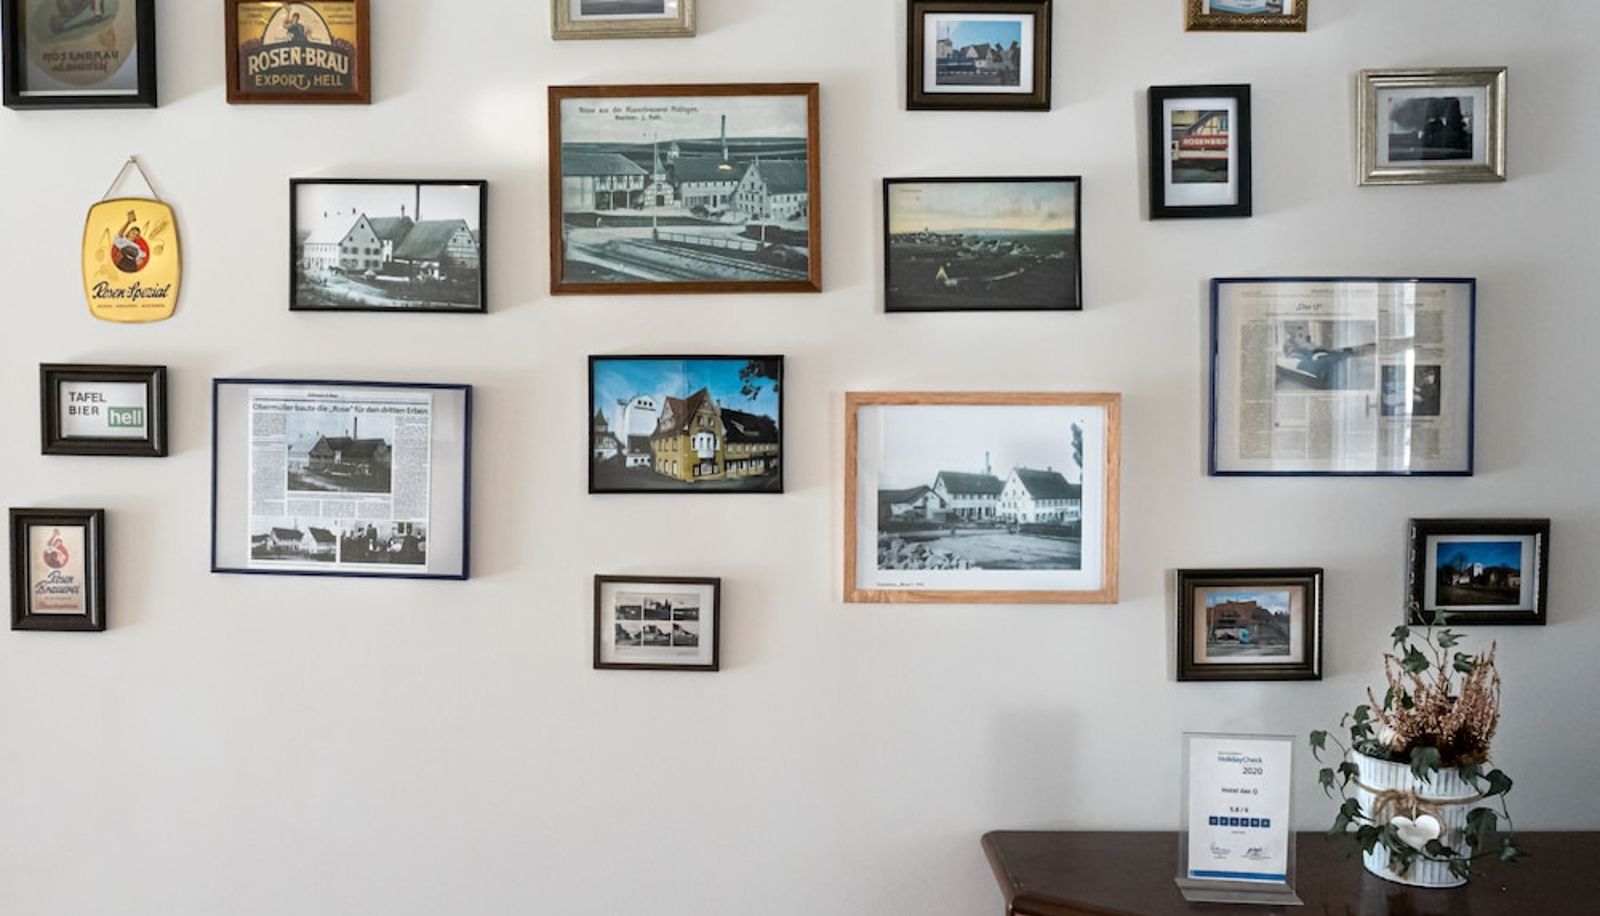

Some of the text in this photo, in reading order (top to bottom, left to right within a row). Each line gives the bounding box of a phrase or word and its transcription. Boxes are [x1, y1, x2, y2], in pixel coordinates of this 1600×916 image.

[255, 74, 344, 90] EXPORT HELL
[68, 391, 107, 403] TAFEL
[68, 405, 100, 416] BIER
[366, 406, 379, 414] den
[406, 407, 428, 415] Erben
[109, 408, 142, 425] hell
[1242, 767, 1263, 775] 2020
